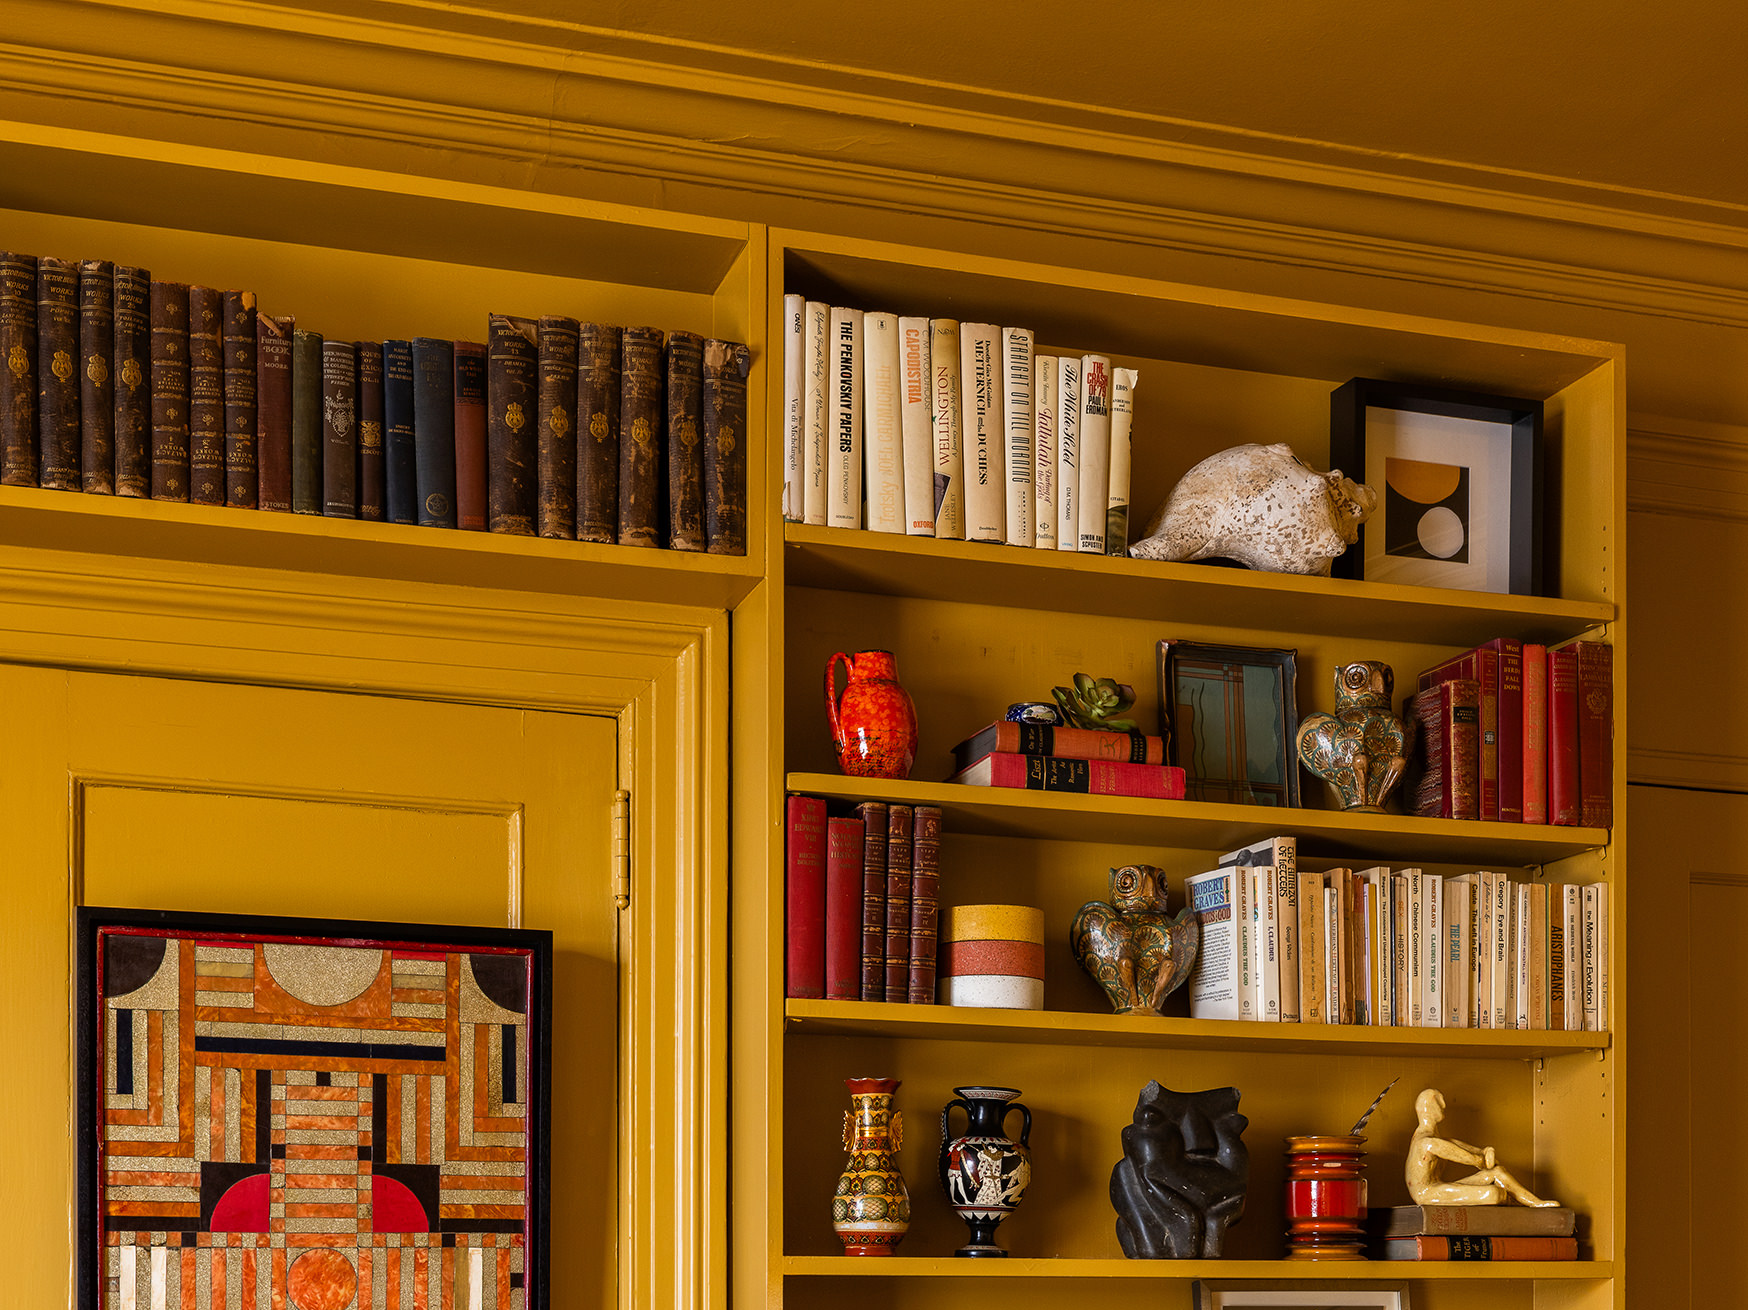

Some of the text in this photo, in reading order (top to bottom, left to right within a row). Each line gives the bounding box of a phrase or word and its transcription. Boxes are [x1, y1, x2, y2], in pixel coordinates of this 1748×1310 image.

[6, 281, 30, 291] WORKS
[50, 286, 74, 296] WORKS
[85, 290, 110, 299] WORKS
[119, 294, 144, 304] WORKS
[264, 362, 288, 370] MOORE
[906, 328, 922, 405] CAPODISTRIA
[975, 339, 986, 416] METTERNICH
[1087, 372, 1109, 387] CRASH
[1092, 361, 1104, 374] THE
[815, 388, 822, 396] A
[840, 320, 853, 453] THE PENKOVSKIY PAPERS
[949, 374, 958, 394] Family
[949, 394, 958, 404] My
[815, 398, 823, 421] Woman
[936, 366, 952, 467] WELLINGTON
[950, 404, 959, 428] Through
[1010, 334, 1031, 484] STRAIGHT ON TILL MORNING
[1062, 364, 1078, 468] The White Hotel
[1085, 404, 1108, 417] ERDMAN
[1088, 395, 1102, 406] PAUL
[790, 398, 799, 471] Vita di Michelangelo
[813, 430, 824, 466] Independent
[875, 365, 899, 525] Trotsky JOEL CARMICHAEL
[950, 429, 959, 452] Journey
[1037, 407, 1053, 467] Tallulah
[976, 433, 988, 486] DUCHESS
[842, 471, 850, 505] PENKOVSKIY
[1035, 470, 1046, 500] the Gods
[1044, 468, 1053, 507] Darling of
[913, 520, 935, 529] OXFORD
[950, 492, 958, 531] WELLESLEY
[1080, 533, 1095, 541] SIMON
[1030, 759, 1042, 780] Liszt
[1193, 876, 1225, 898] ROBERT
[1278, 845, 1289, 898] OF LETTERS
[1287, 846, 1297, 908] THE AMAZON
[1193, 891, 1226, 911] GRAVES
[1412, 874, 1420, 977] North Chinese Communism
[1496, 881, 1505, 962] Gregory Eye and Brain
[1450, 924, 1461, 963] THE PEARL
[1585, 921, 1594, 959] Meaning
[1470, 946, 1478, 972] Europe
[1551, 925, 1564, 1002] ARISTOPHANES
[1586, 966, 1594, 1005] Evolution
